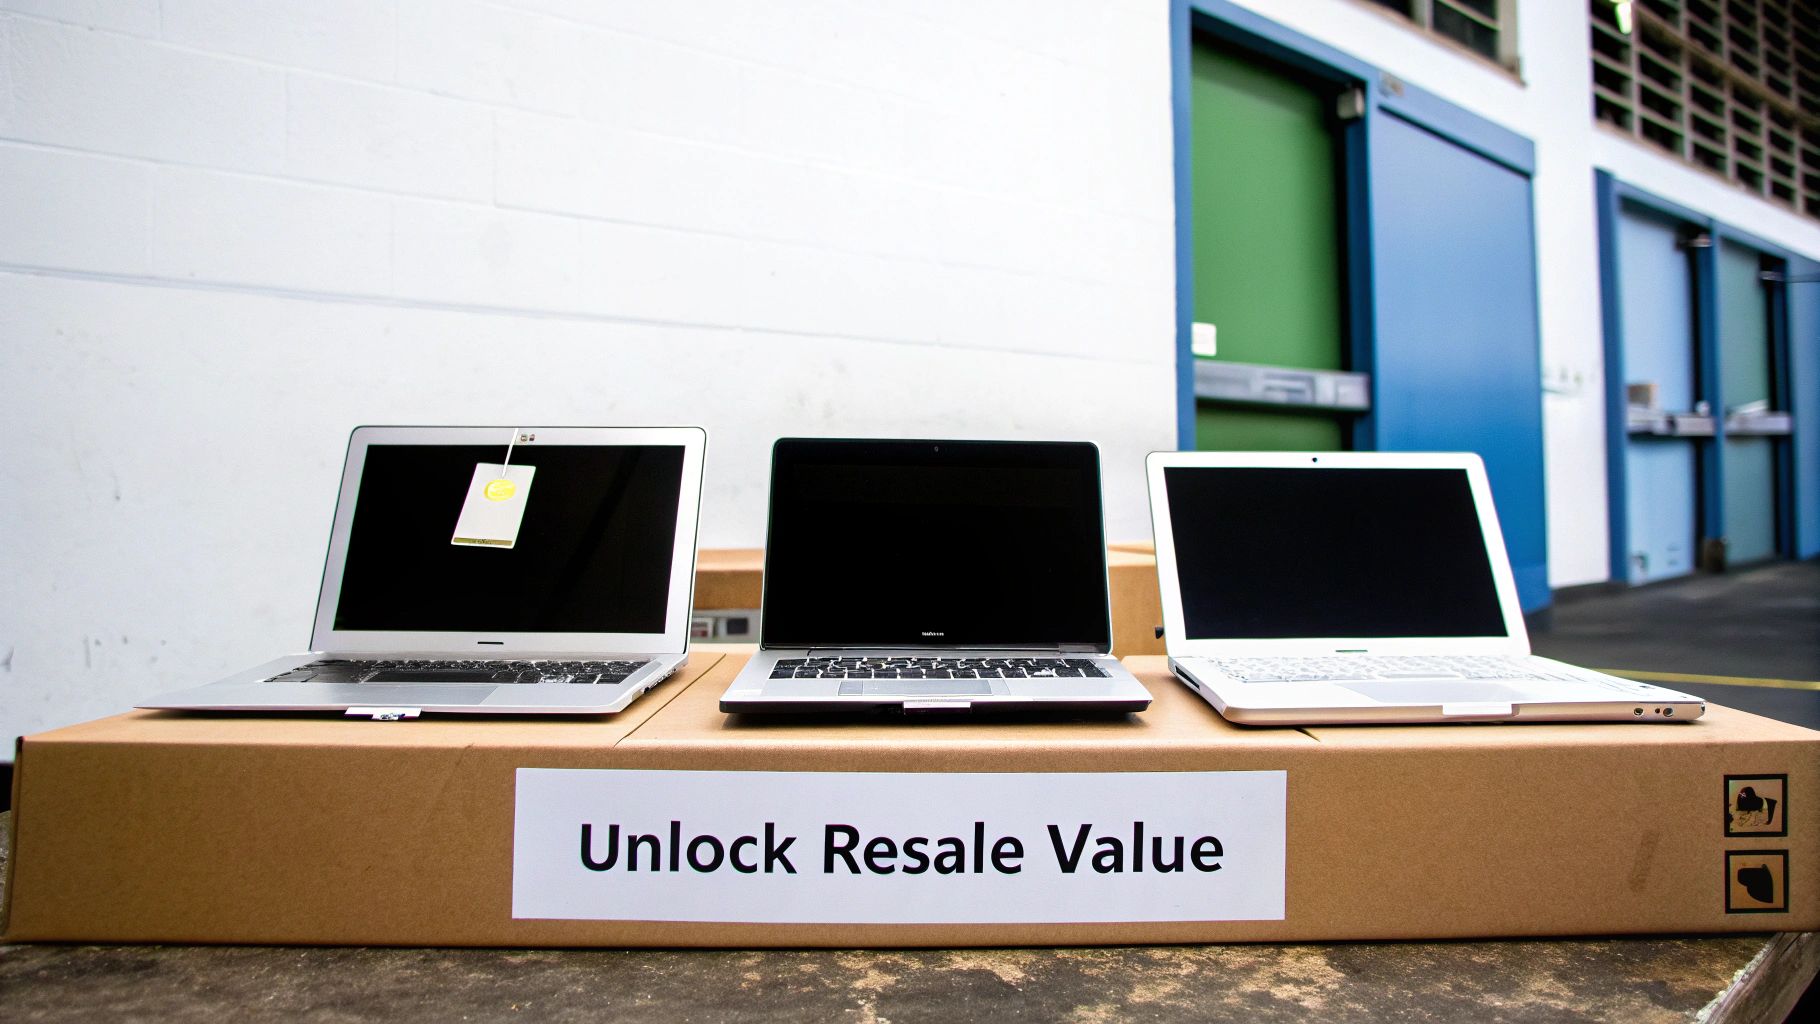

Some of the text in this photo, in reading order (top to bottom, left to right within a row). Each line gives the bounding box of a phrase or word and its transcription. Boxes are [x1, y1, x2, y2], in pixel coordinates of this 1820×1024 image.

[580, 821, 1225, 875] Unlock Resale Value
